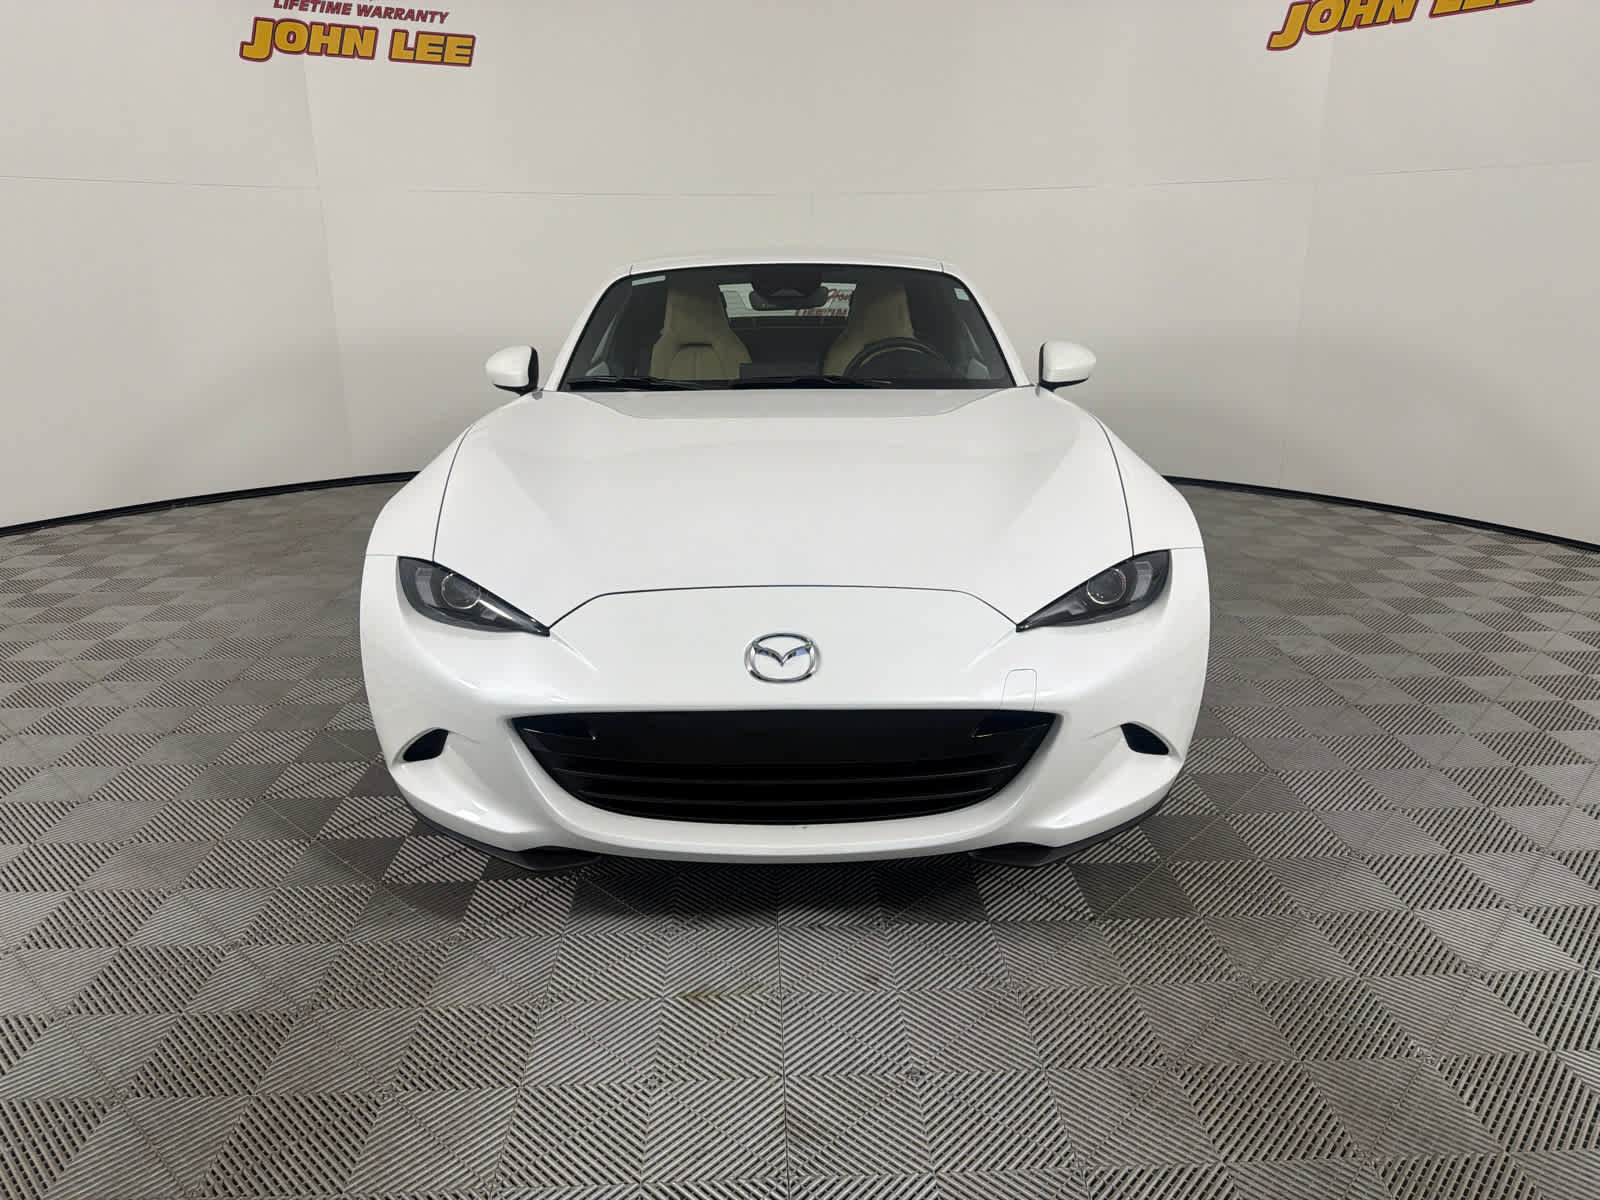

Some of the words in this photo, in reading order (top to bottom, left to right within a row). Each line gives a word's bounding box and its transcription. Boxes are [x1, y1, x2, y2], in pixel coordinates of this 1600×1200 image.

[273, 0, 353, 15] LIFETIME
[356, 4, 449, 24] WARRANTY
[1266, 0, 1419, 51] JOHN
[239, 17, 379, 63] JOHN
[388, 28, 476, 67] LEE
